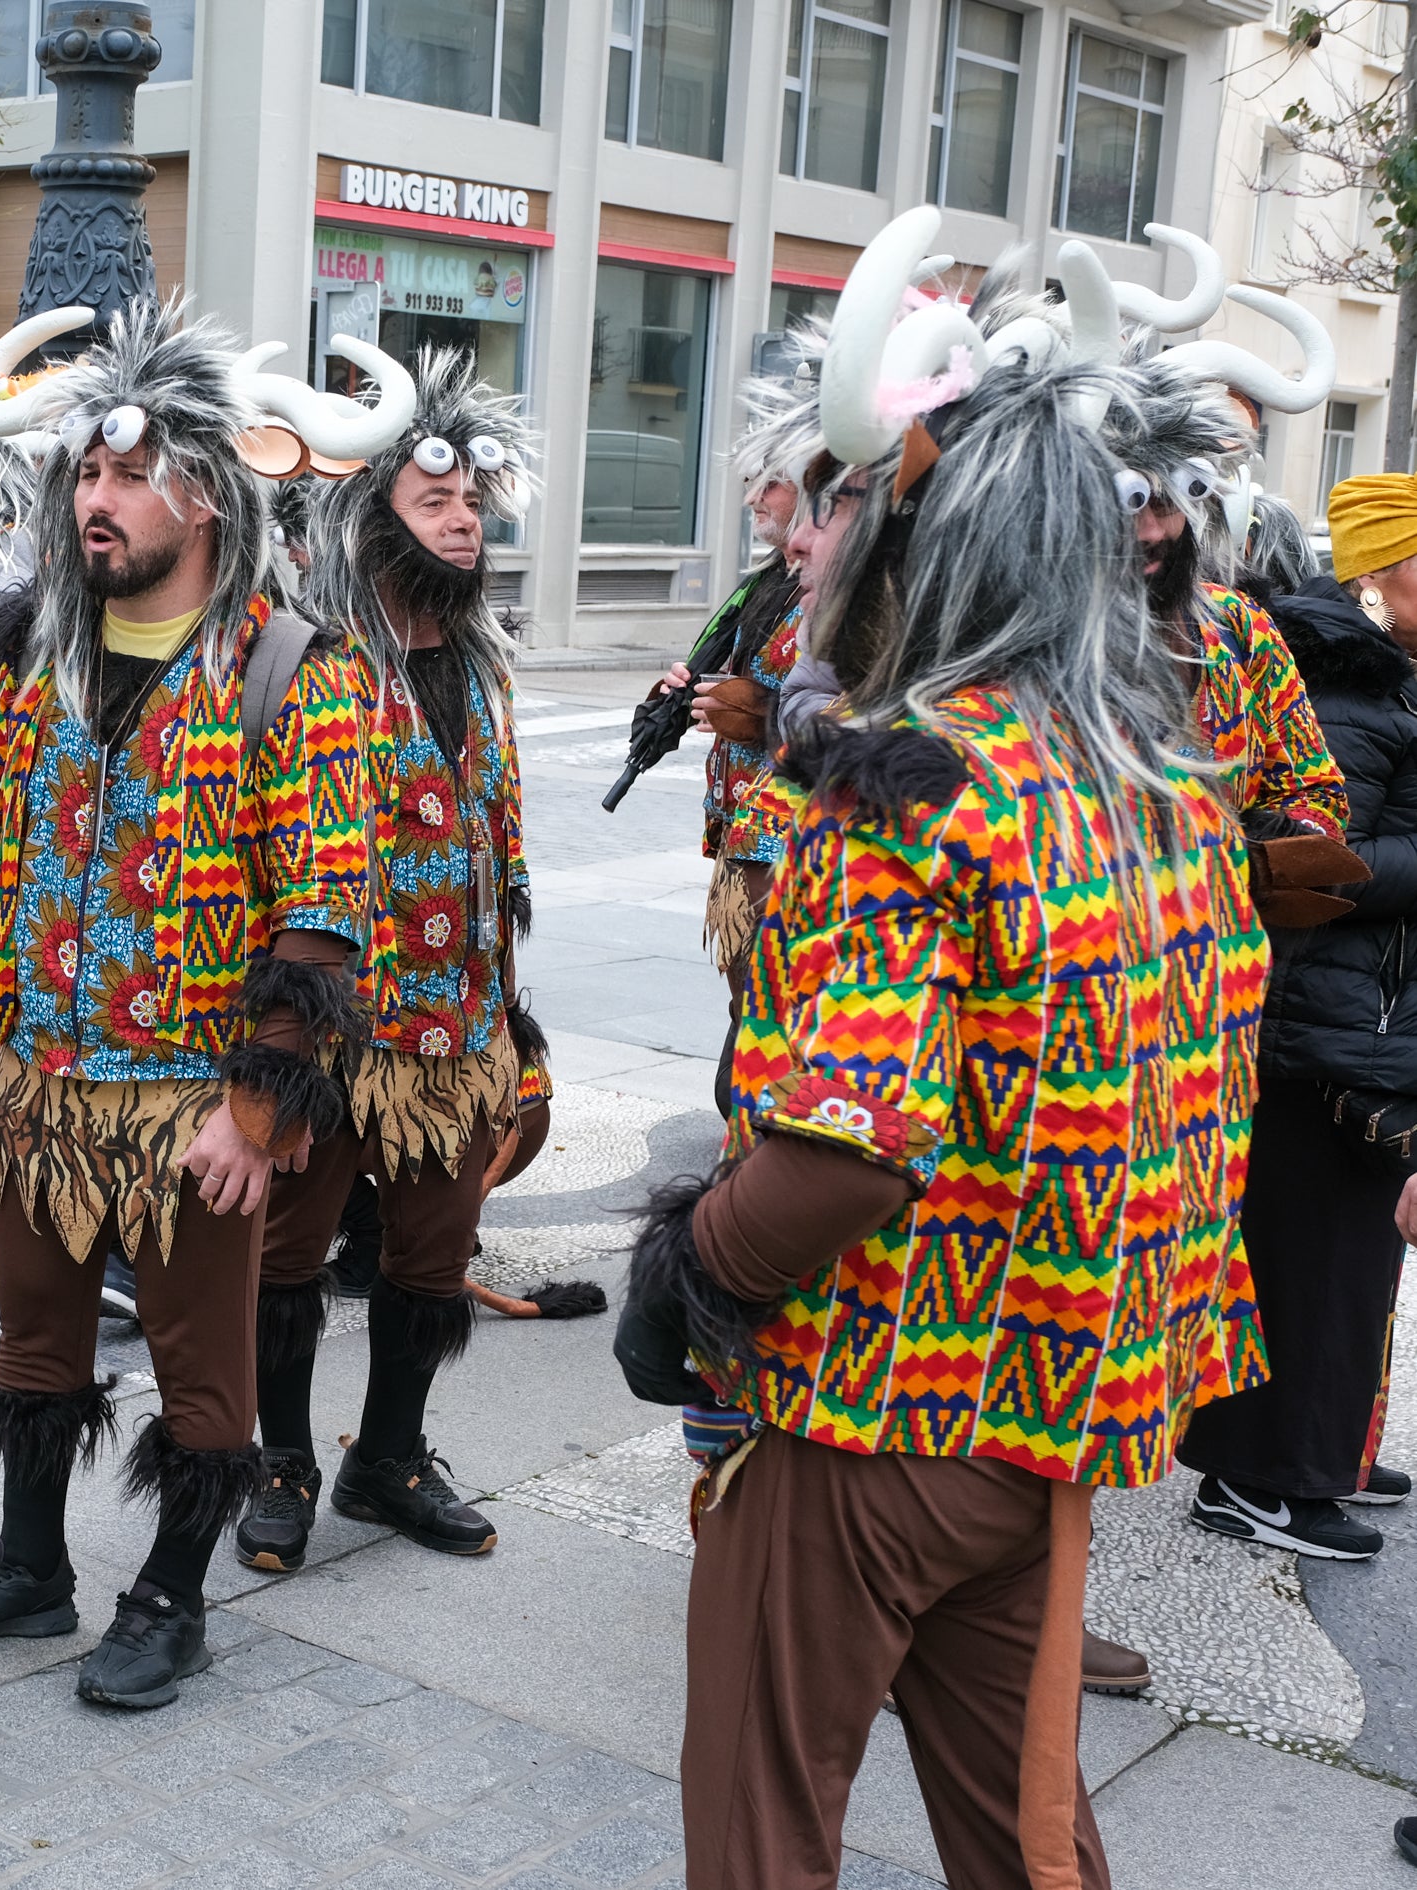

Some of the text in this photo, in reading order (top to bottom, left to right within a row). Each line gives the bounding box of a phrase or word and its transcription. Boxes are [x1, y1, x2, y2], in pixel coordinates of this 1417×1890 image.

[344, 164, 529, 227] BURGER KING
[318, 248, 469, 294] LLEGA A TU CASA
[405, 291, 464, 315] 911 933 933
